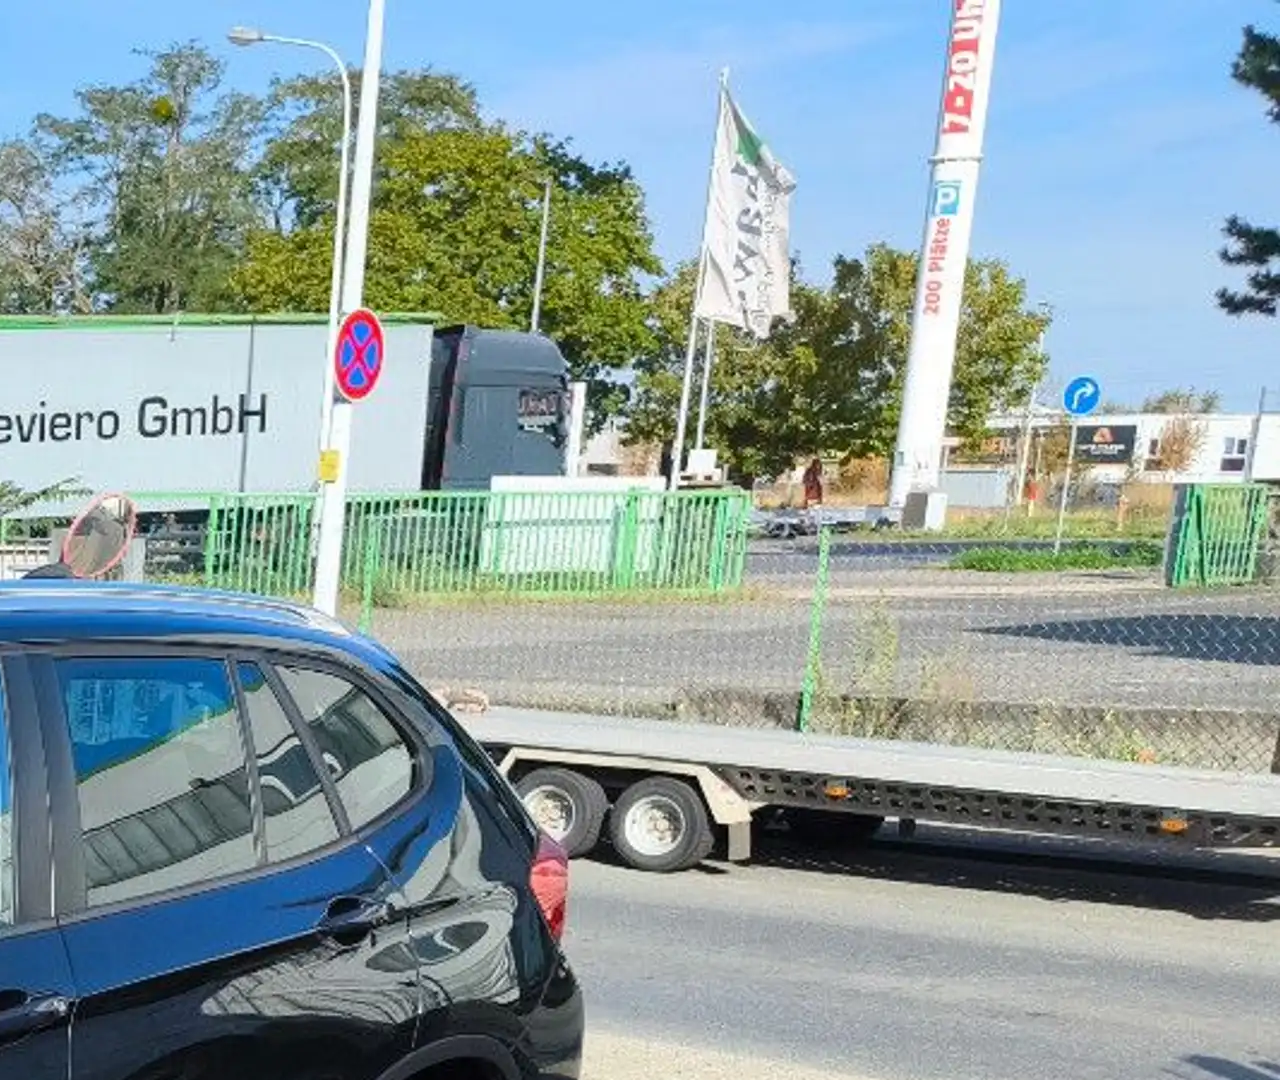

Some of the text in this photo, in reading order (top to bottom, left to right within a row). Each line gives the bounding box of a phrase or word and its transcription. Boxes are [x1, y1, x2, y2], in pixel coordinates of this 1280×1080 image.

[923, 217, 952, 316] 200 Plätze
[138, 393, 268, 438] GmbH
